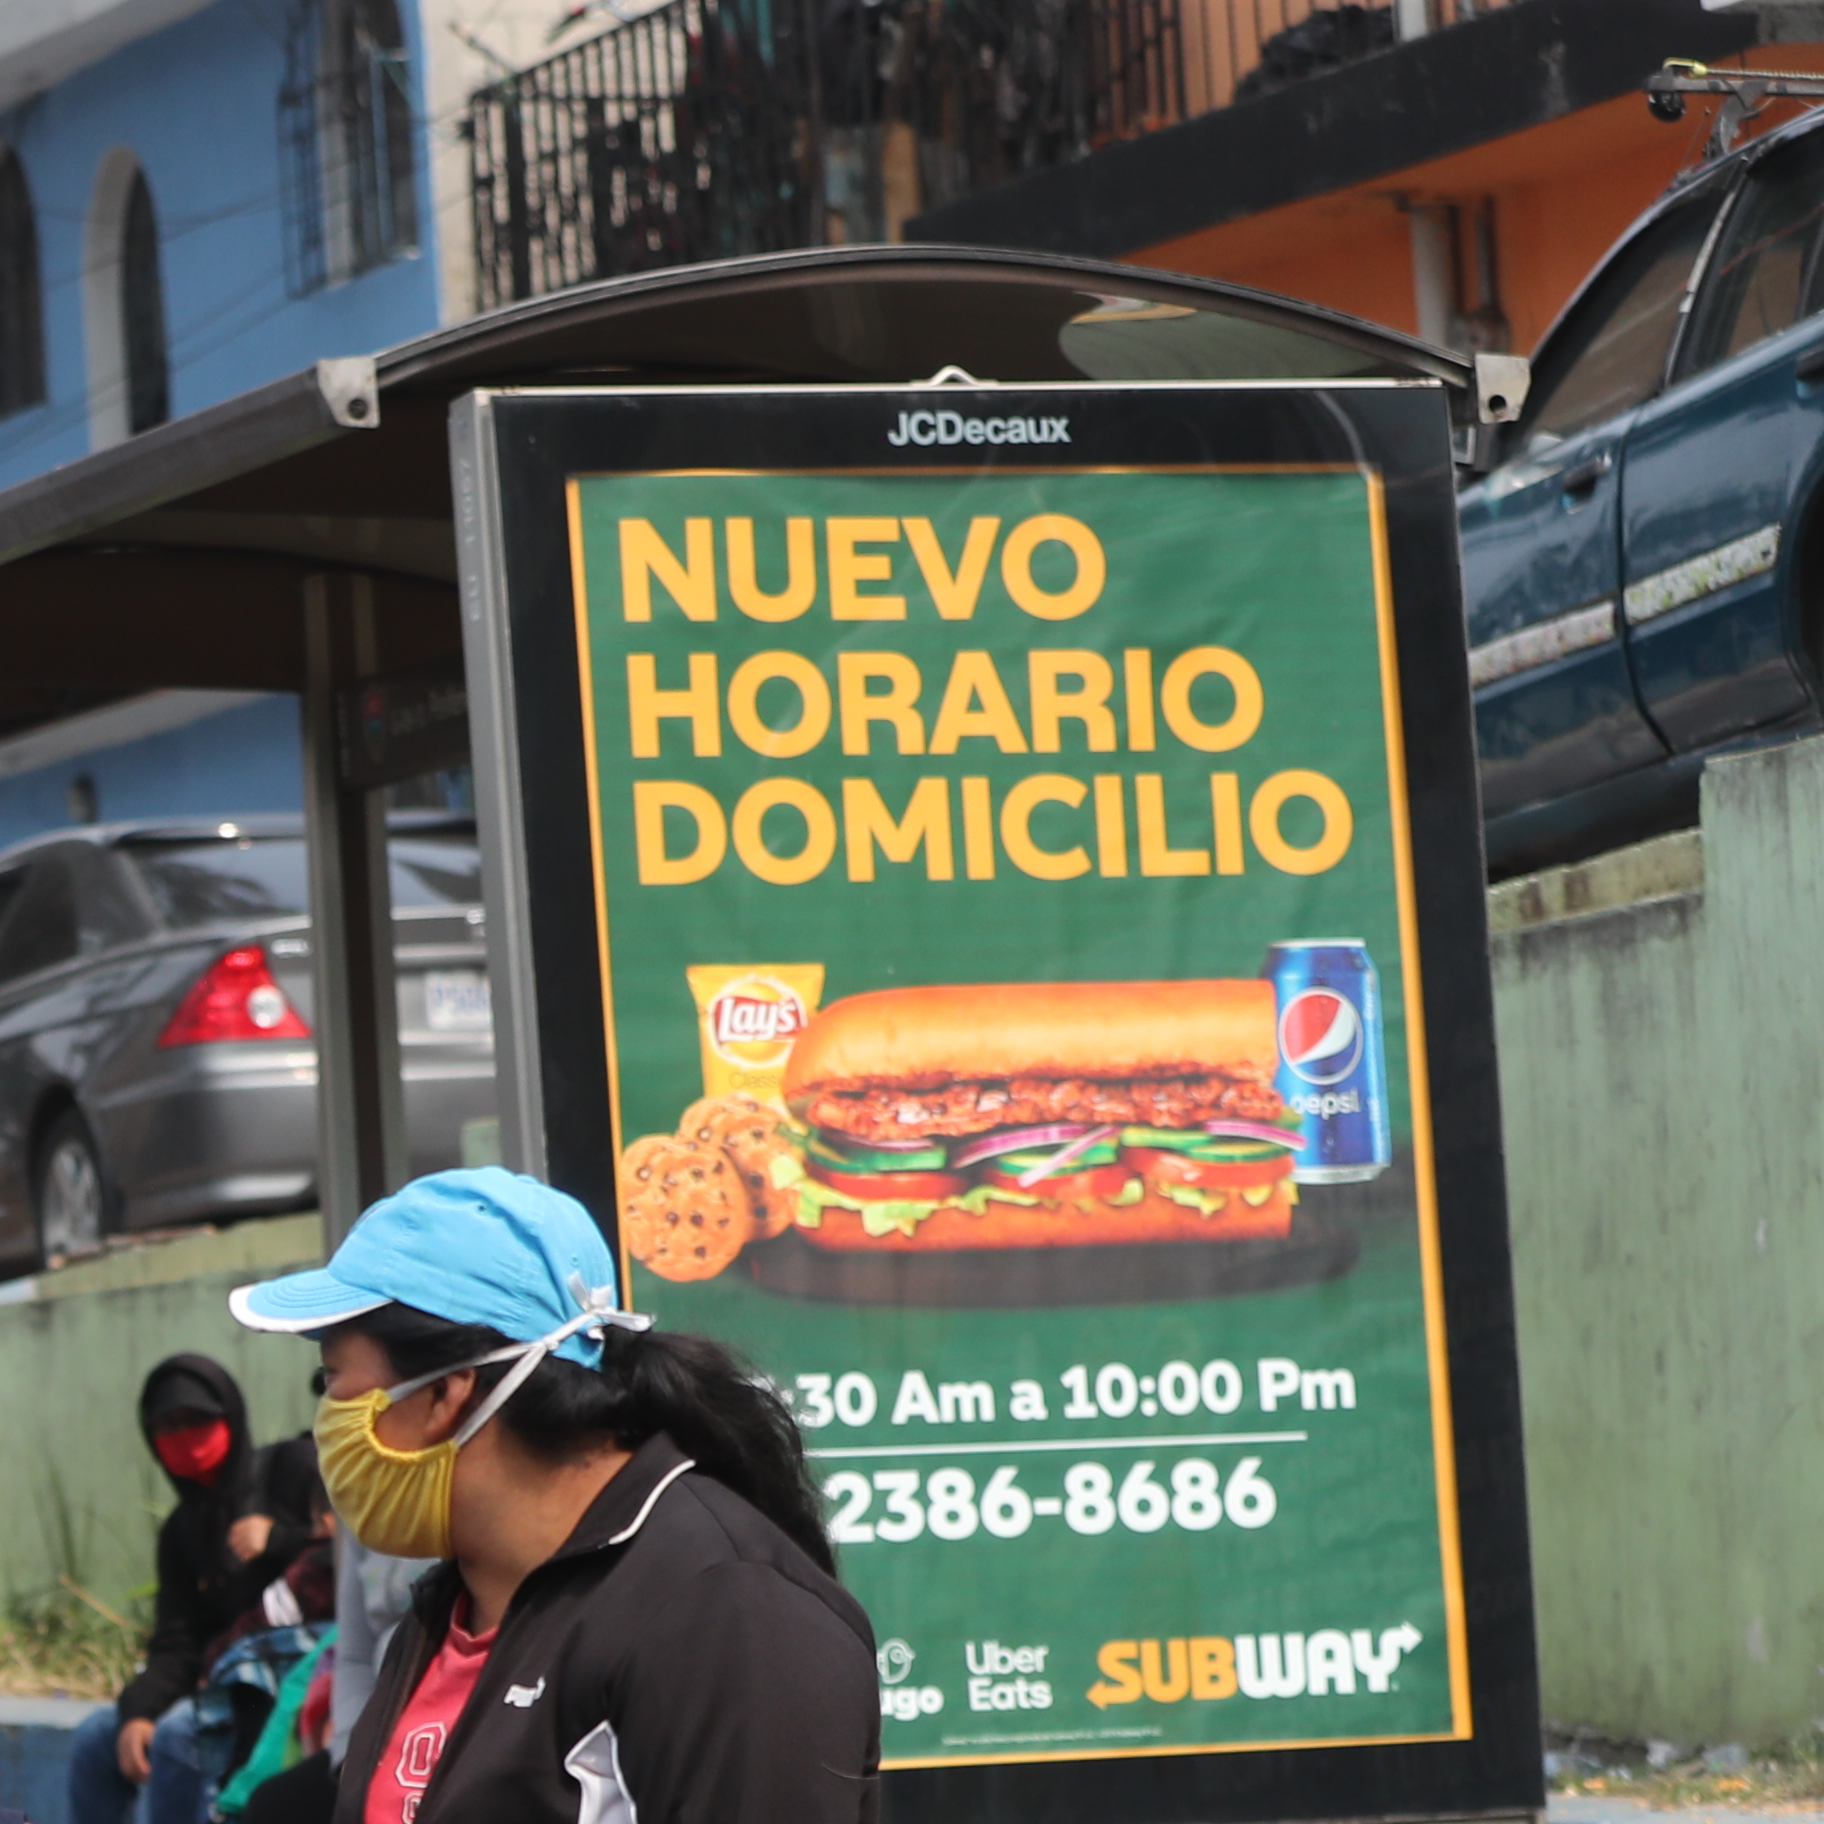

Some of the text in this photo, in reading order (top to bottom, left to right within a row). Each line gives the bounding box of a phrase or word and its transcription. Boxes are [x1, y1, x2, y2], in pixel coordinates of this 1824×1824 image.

[886, 411, 1072, 446] JCDecaux
[618, 513, 1107, 622] NUEVO
[626, 645, 1264, 759] HORARIO
[632, 768, 1354, 886] DOMICILIO
[891, 1369, 997, 1425] Am
[1008, 1378, 1050, 1422] a
[1060, 1359, 1244, 1420] 10:00
[1257, 1357, 1358, 1413] Pm
[822, 1455, 1278, 1545] 2386-8686
[964, 1639, 1050, 1676] Uber
[967, 1675, 1054, 1712] Eats
[1086, 1620, 1424, 1710] SUBWAY
